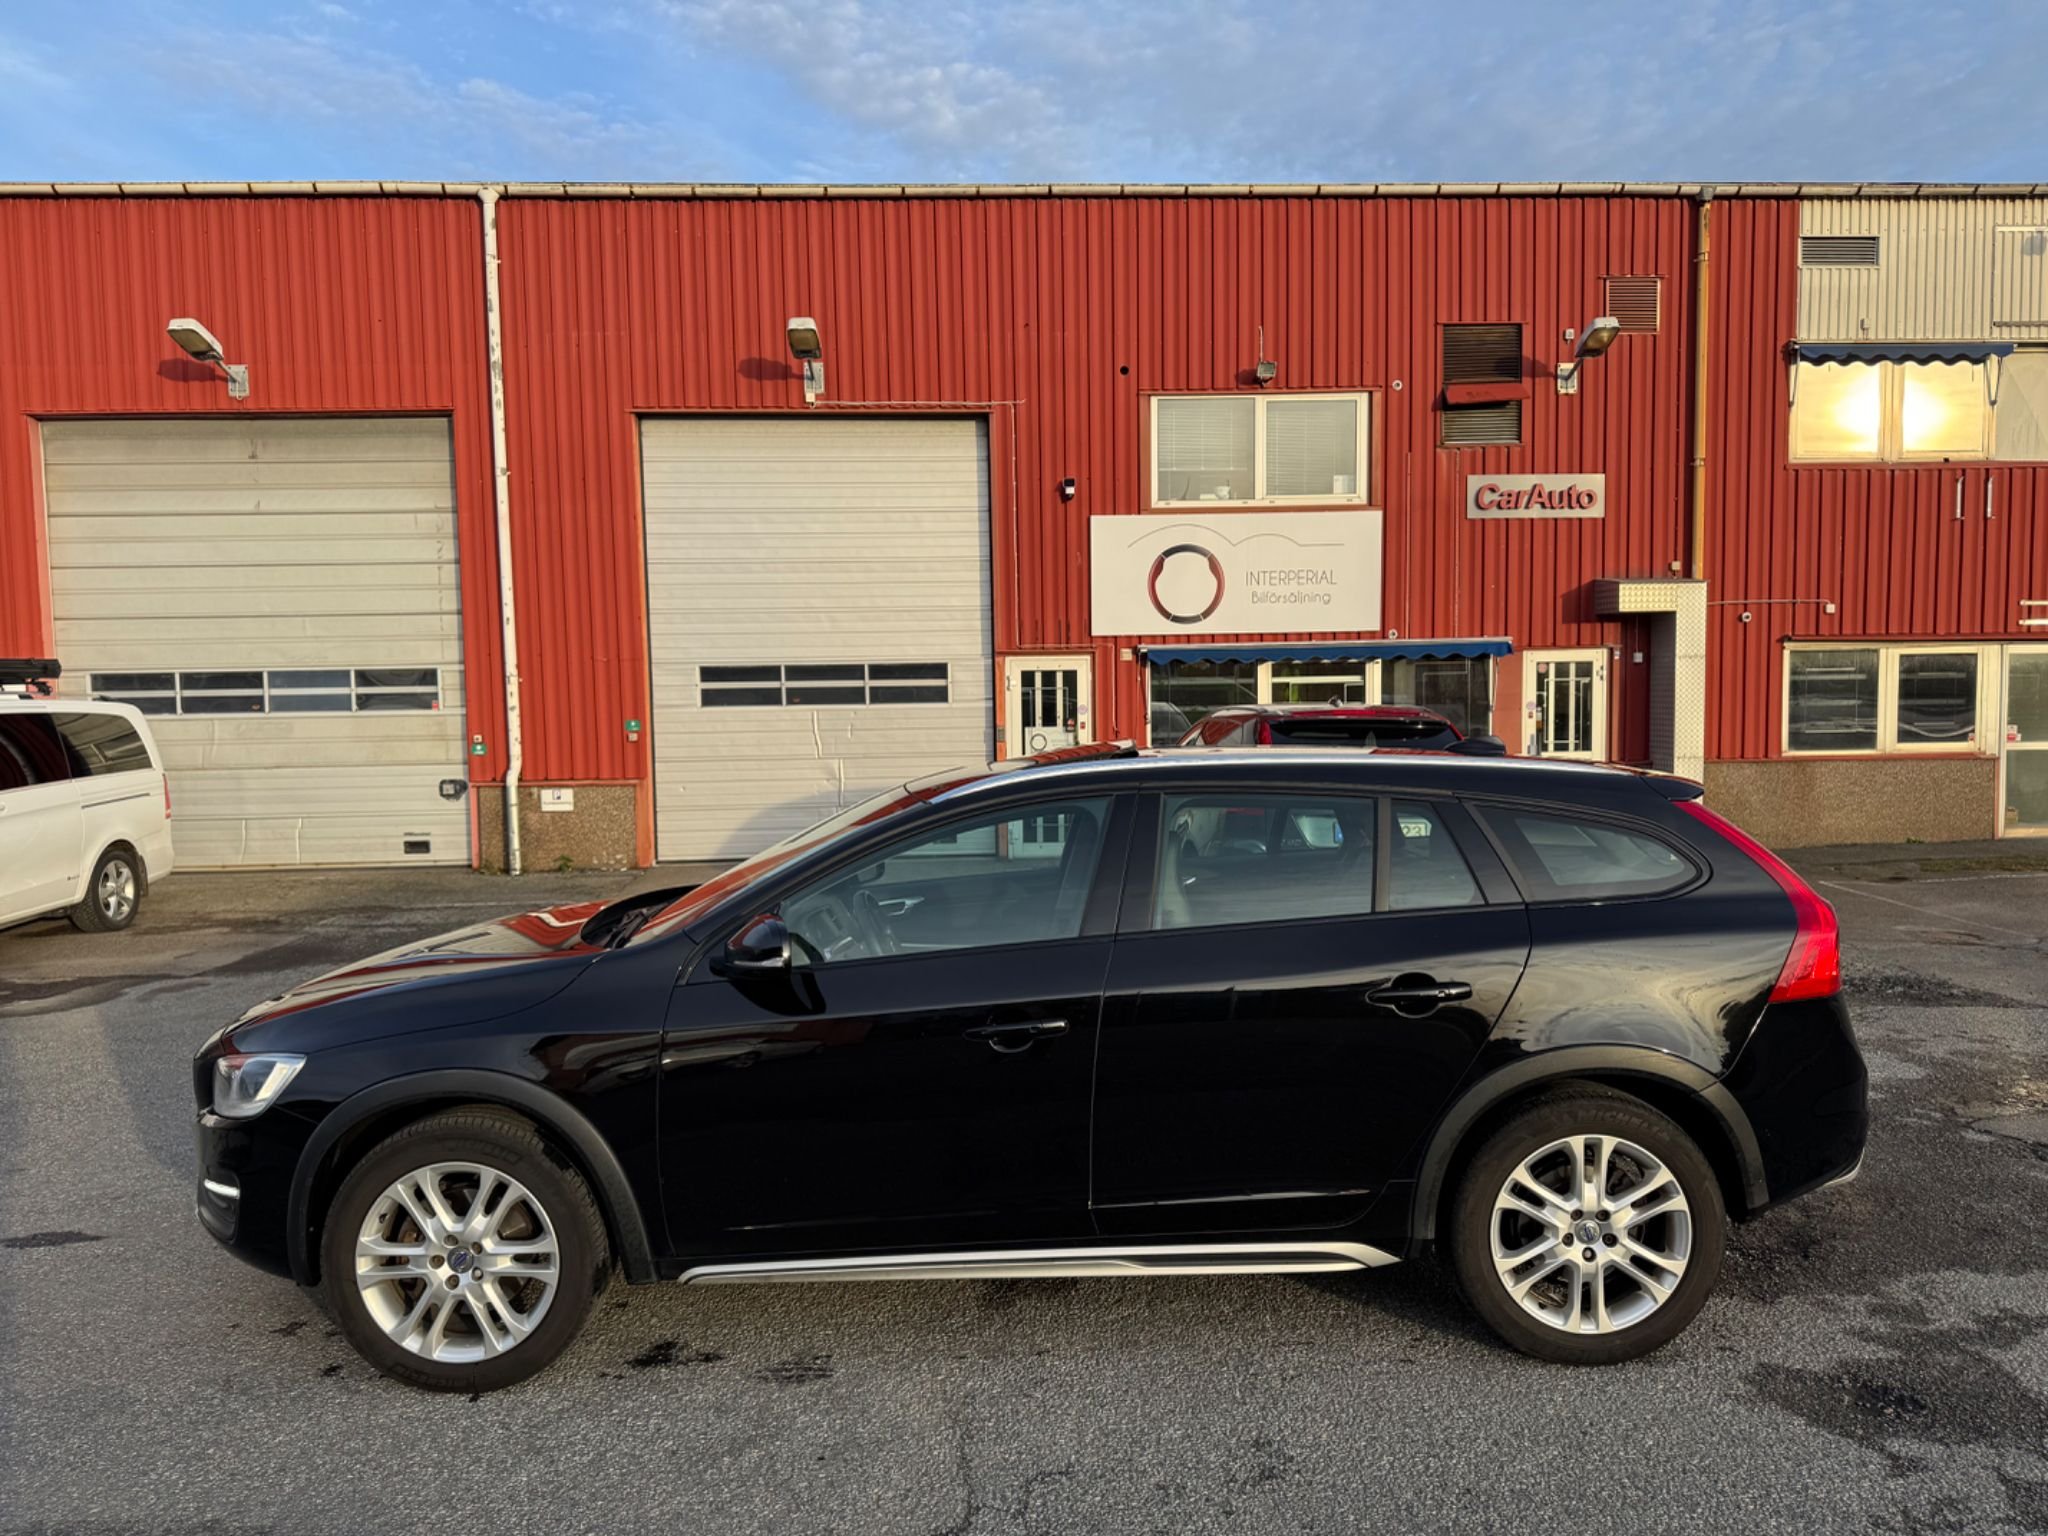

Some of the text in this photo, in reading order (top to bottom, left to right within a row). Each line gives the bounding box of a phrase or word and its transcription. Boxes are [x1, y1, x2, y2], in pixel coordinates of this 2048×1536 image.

[1475, 482, 1598, 511] CarAuto
[1245, 569, 1337, 586] INTERPERIAL
[1251, 590, 1332, 605] Bilförsäljning
